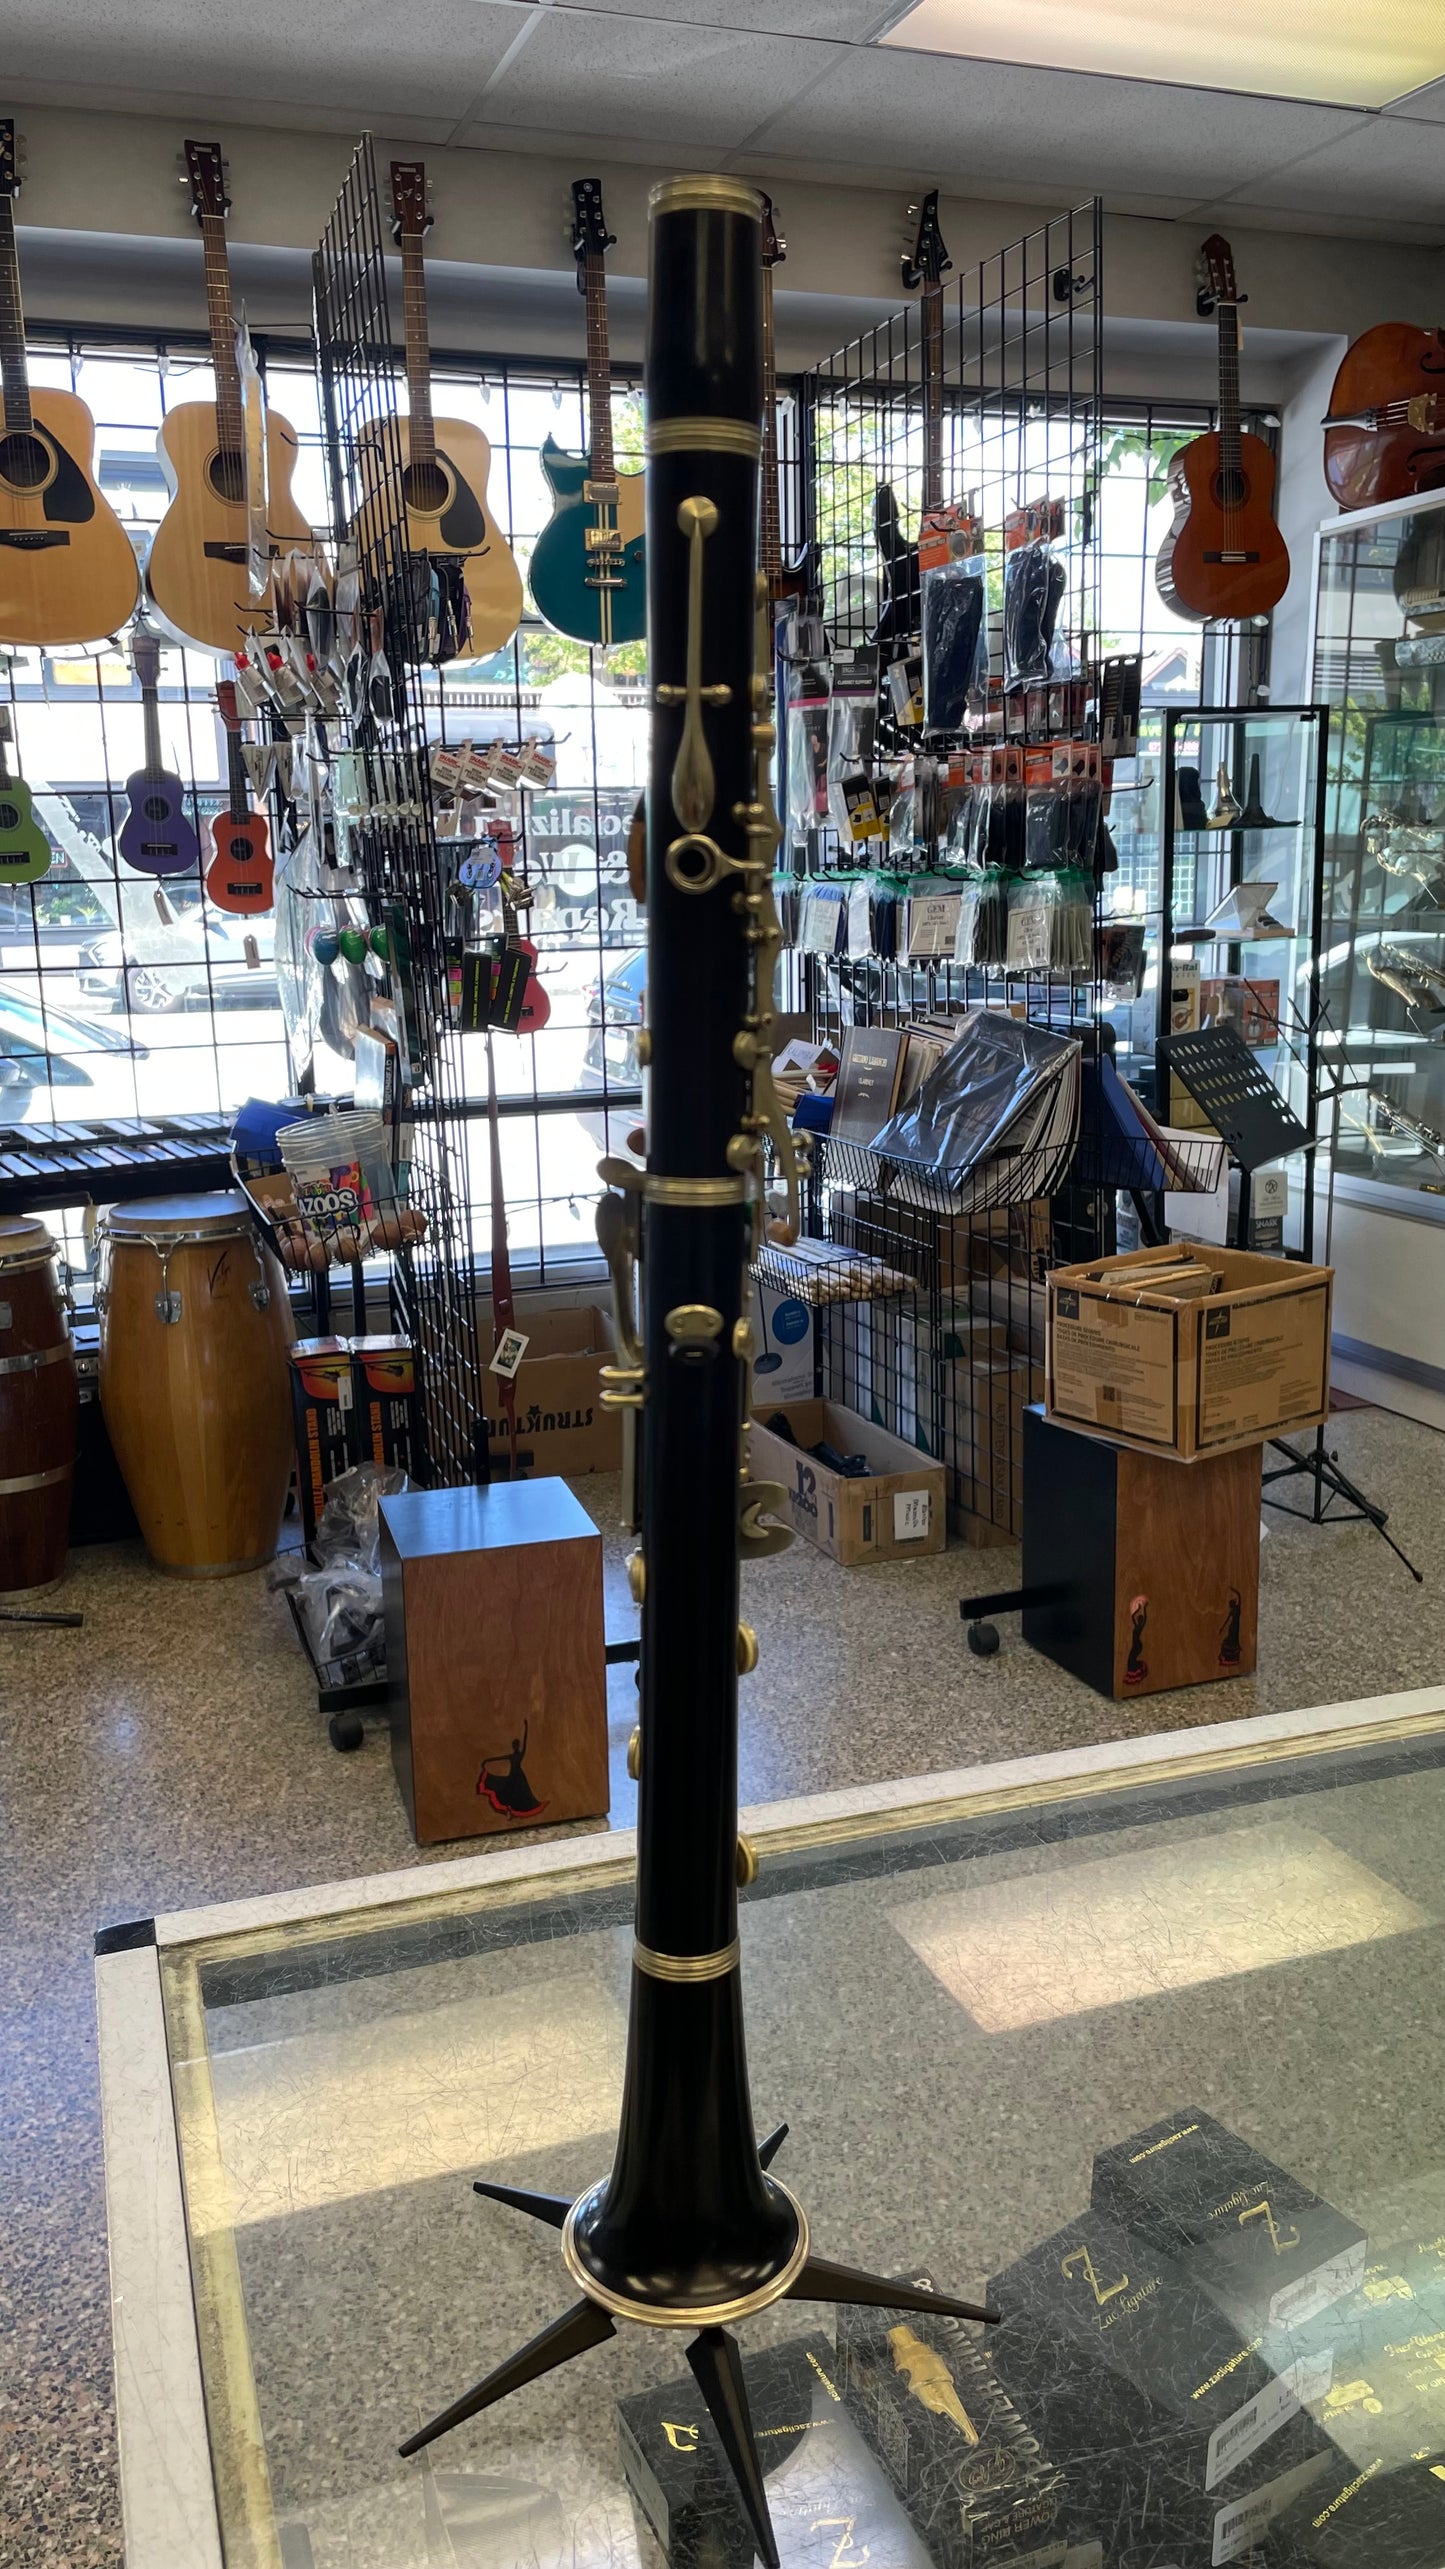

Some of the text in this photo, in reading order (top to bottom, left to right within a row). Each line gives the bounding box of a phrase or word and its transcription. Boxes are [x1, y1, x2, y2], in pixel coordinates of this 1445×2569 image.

[299, 1189, 354, 1217] AZOOS
[1255, 1218, 1279, 1230] SNARK
[305, 1408, 319, 1438] STAND
[369, 1401, 382, 1432] STAND
[1128, 2123, 1200, 2164] www.zacligature.com
[1091, 2275, 1164, 2331] Zac Ligature
[805, 2351, 842, 2402] acligature.com
[1189, 2336, 1264, 2400] www.zacligature.com
[1311, 2458, 1384, 2529] www.zacligature.com
[1015, 2509, 1059, 2534] POWER
